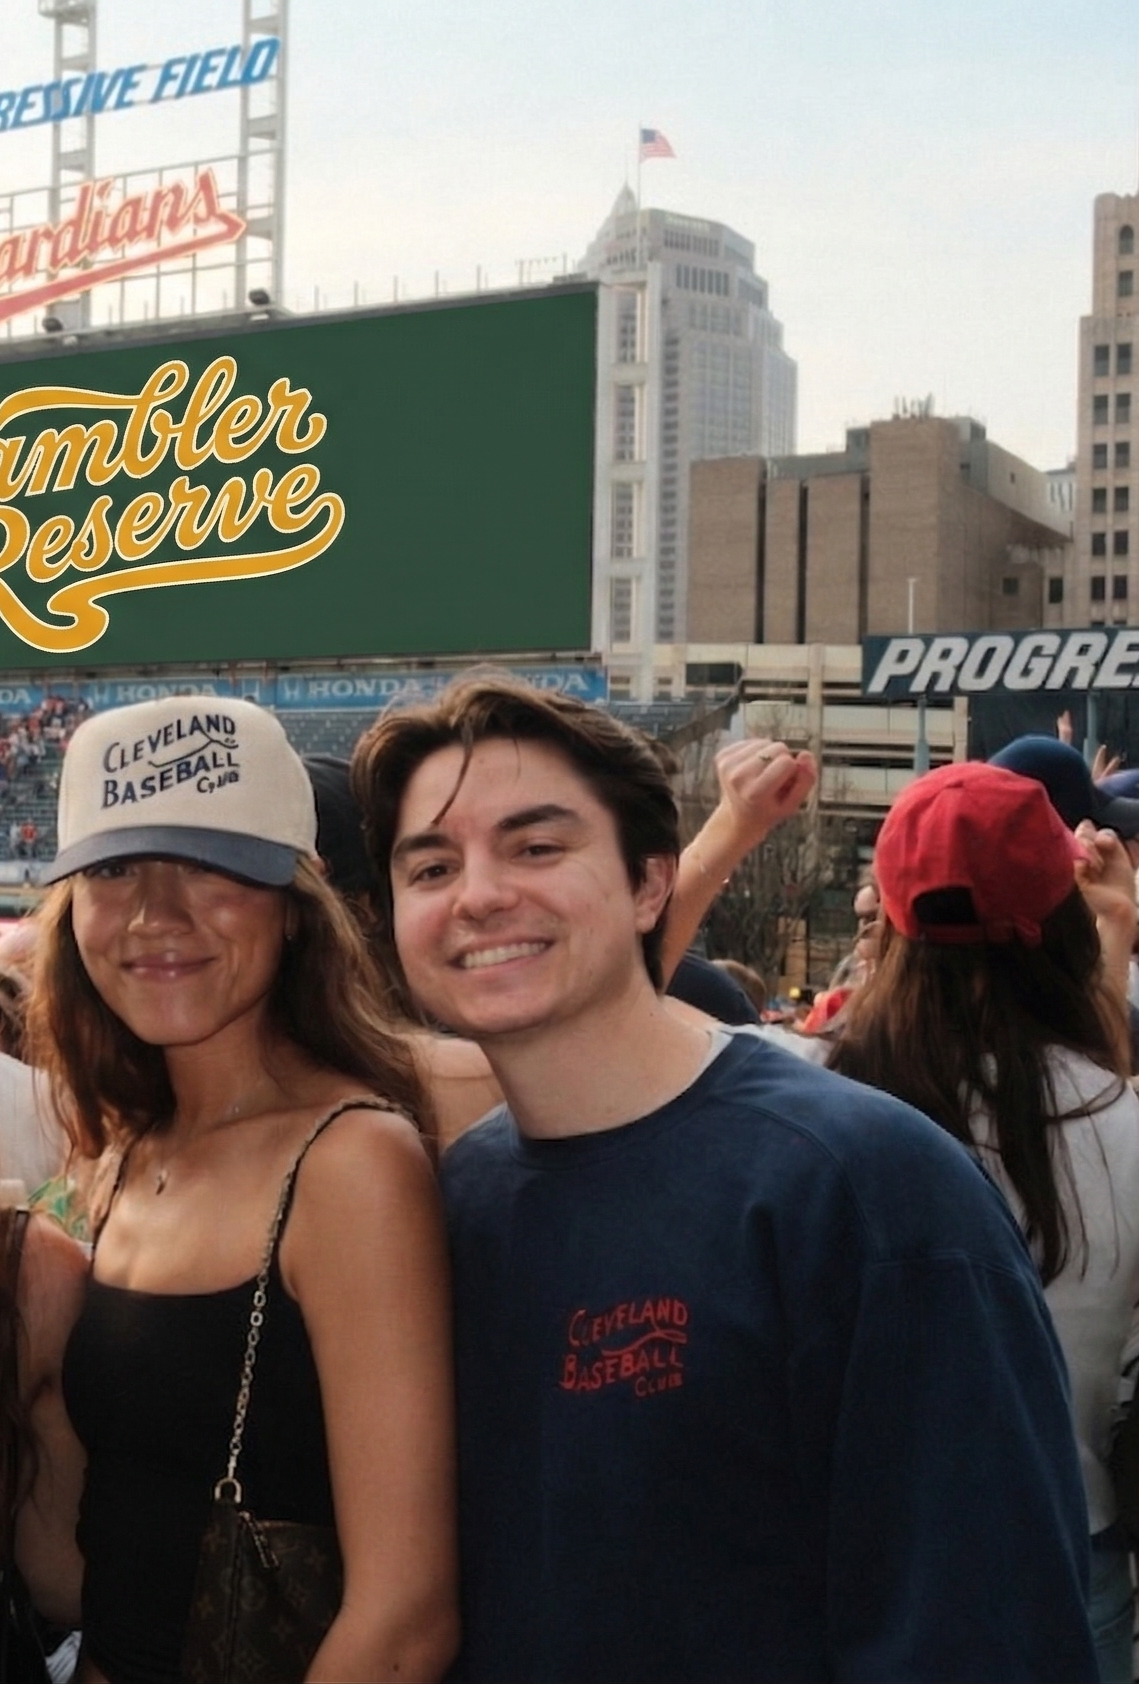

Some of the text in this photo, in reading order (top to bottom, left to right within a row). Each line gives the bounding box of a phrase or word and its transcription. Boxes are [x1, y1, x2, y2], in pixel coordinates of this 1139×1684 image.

[152, 37, 281, 104] FIELD
[866, 630, 1139, 693] PROGRE
[102, 713, 237, 774] CLEVELAND
[101, 751, 241, 809] BASEBALL
[559, 1347, 685, 1391] BASEBALL
